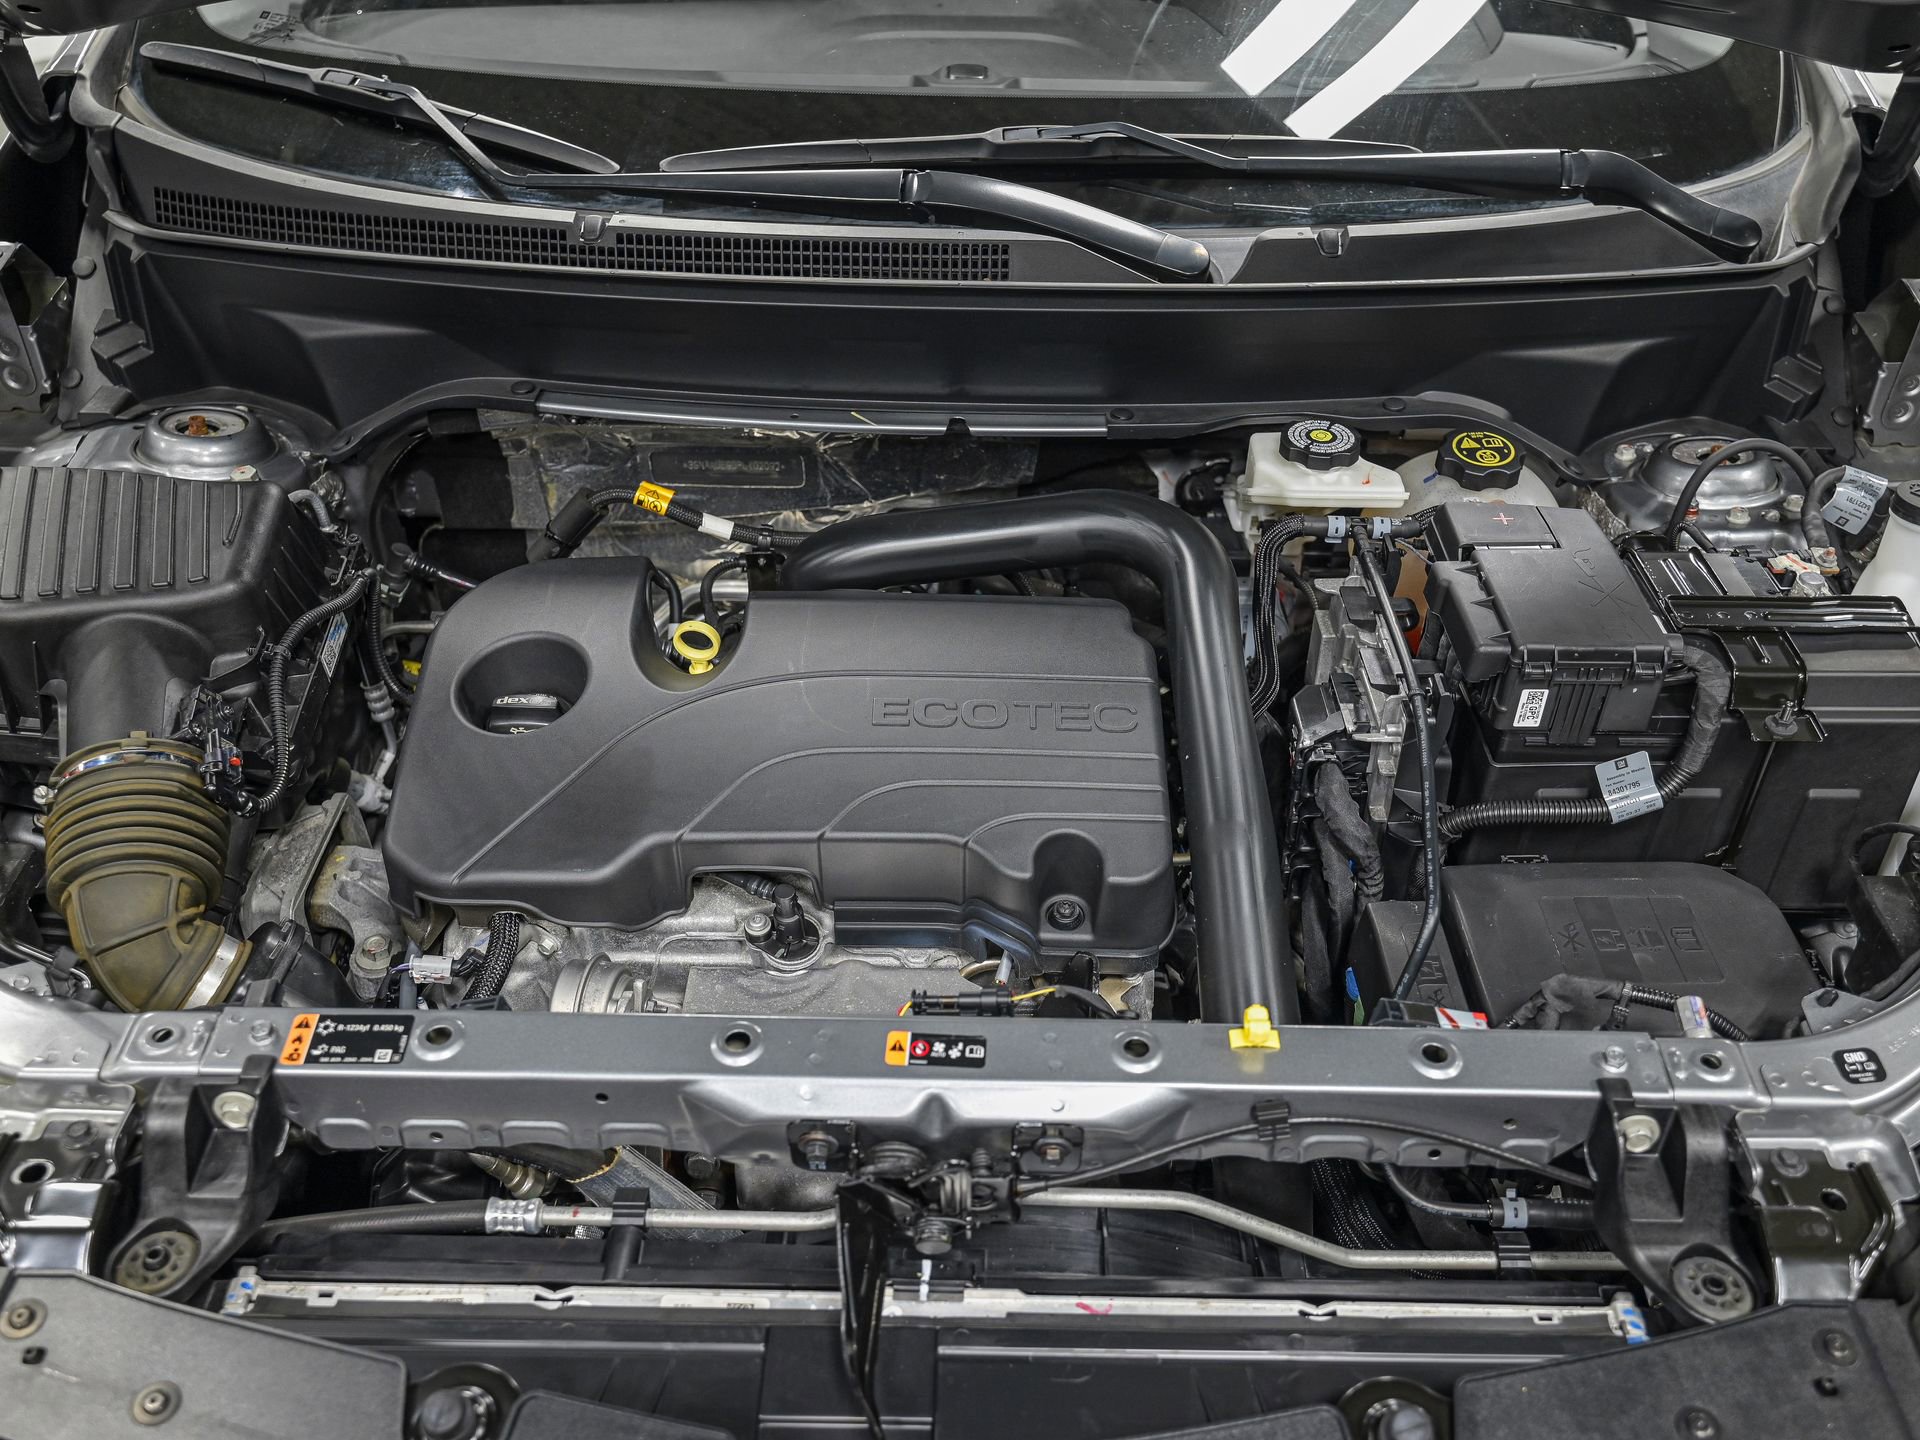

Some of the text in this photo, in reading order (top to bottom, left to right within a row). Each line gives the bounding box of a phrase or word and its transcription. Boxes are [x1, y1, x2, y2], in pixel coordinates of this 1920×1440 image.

[872, 698, 1138, 733] ECOTEC
[1527, 706, 1537, 719] GPC
[1607, 780, 1641, 797] 84301795
[336, 1024, 370, 1032] R-1234yf
[394, 1024, 404, 1032] kg
[329, 1045, 347, 1053] PAG
[1843, 1051, 1868, 1063] GND
